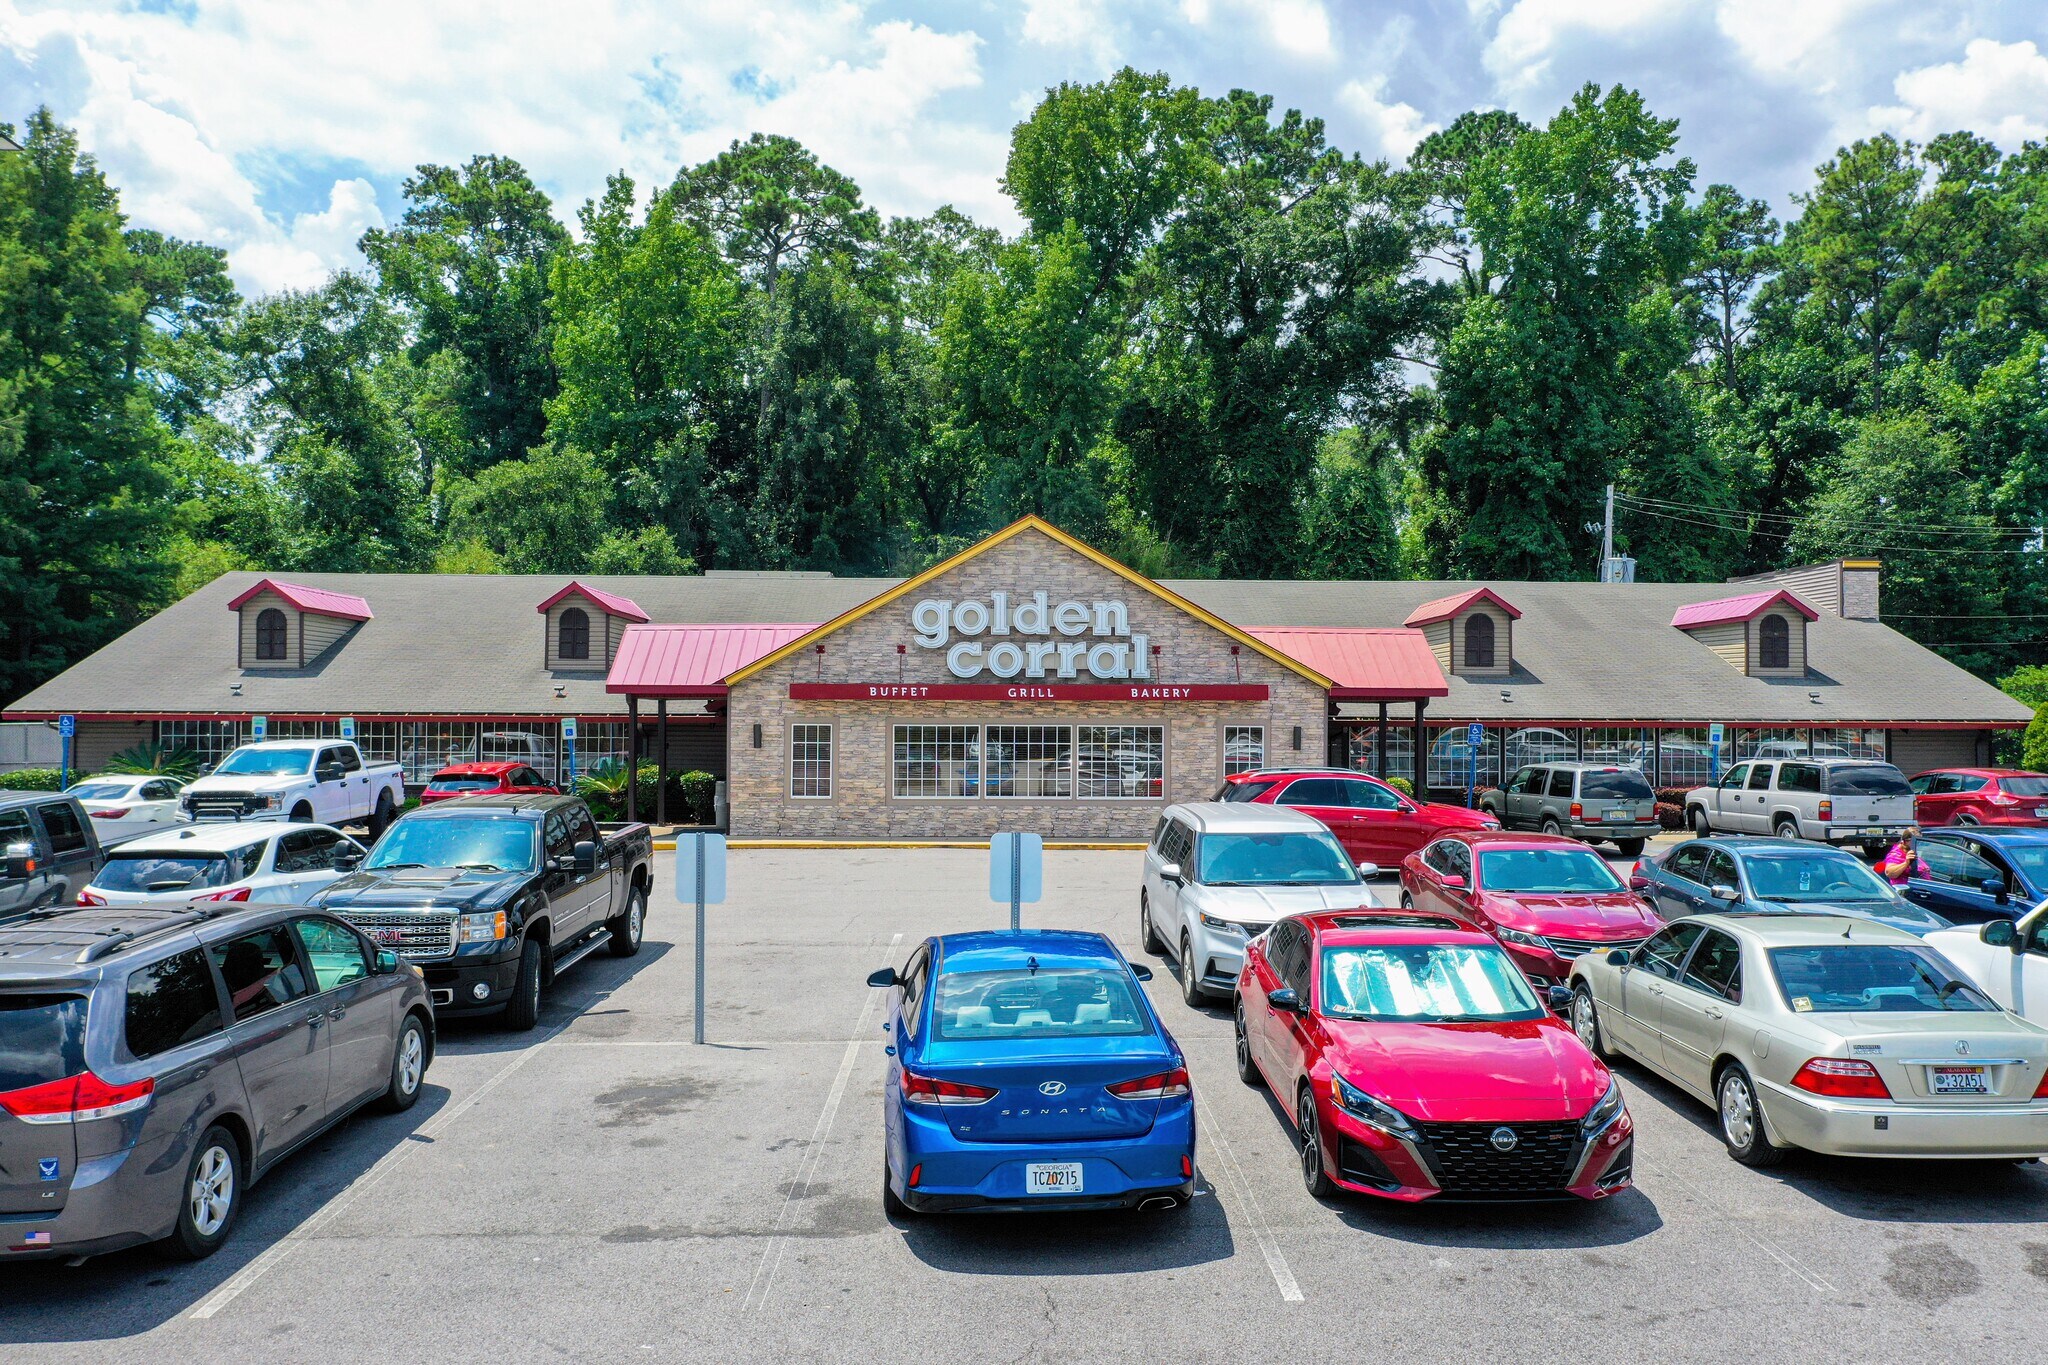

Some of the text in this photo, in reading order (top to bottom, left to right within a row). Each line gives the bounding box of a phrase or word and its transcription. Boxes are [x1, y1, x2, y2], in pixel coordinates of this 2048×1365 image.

[912, 590, 1130, 648] golden
[946, 634, 1150, 679] corral
[869, 687, 928, 697] BUFFET
[1007, 688, 1054, 698] GRILL
[1130, 688, 1190, 698] BAKERY
[1951, 1074, 1984, 1088] 32A51
[1001, 1107, 1106, 1116] SONATA
[1032, 1170, 1078, 1186] TCZ0215
